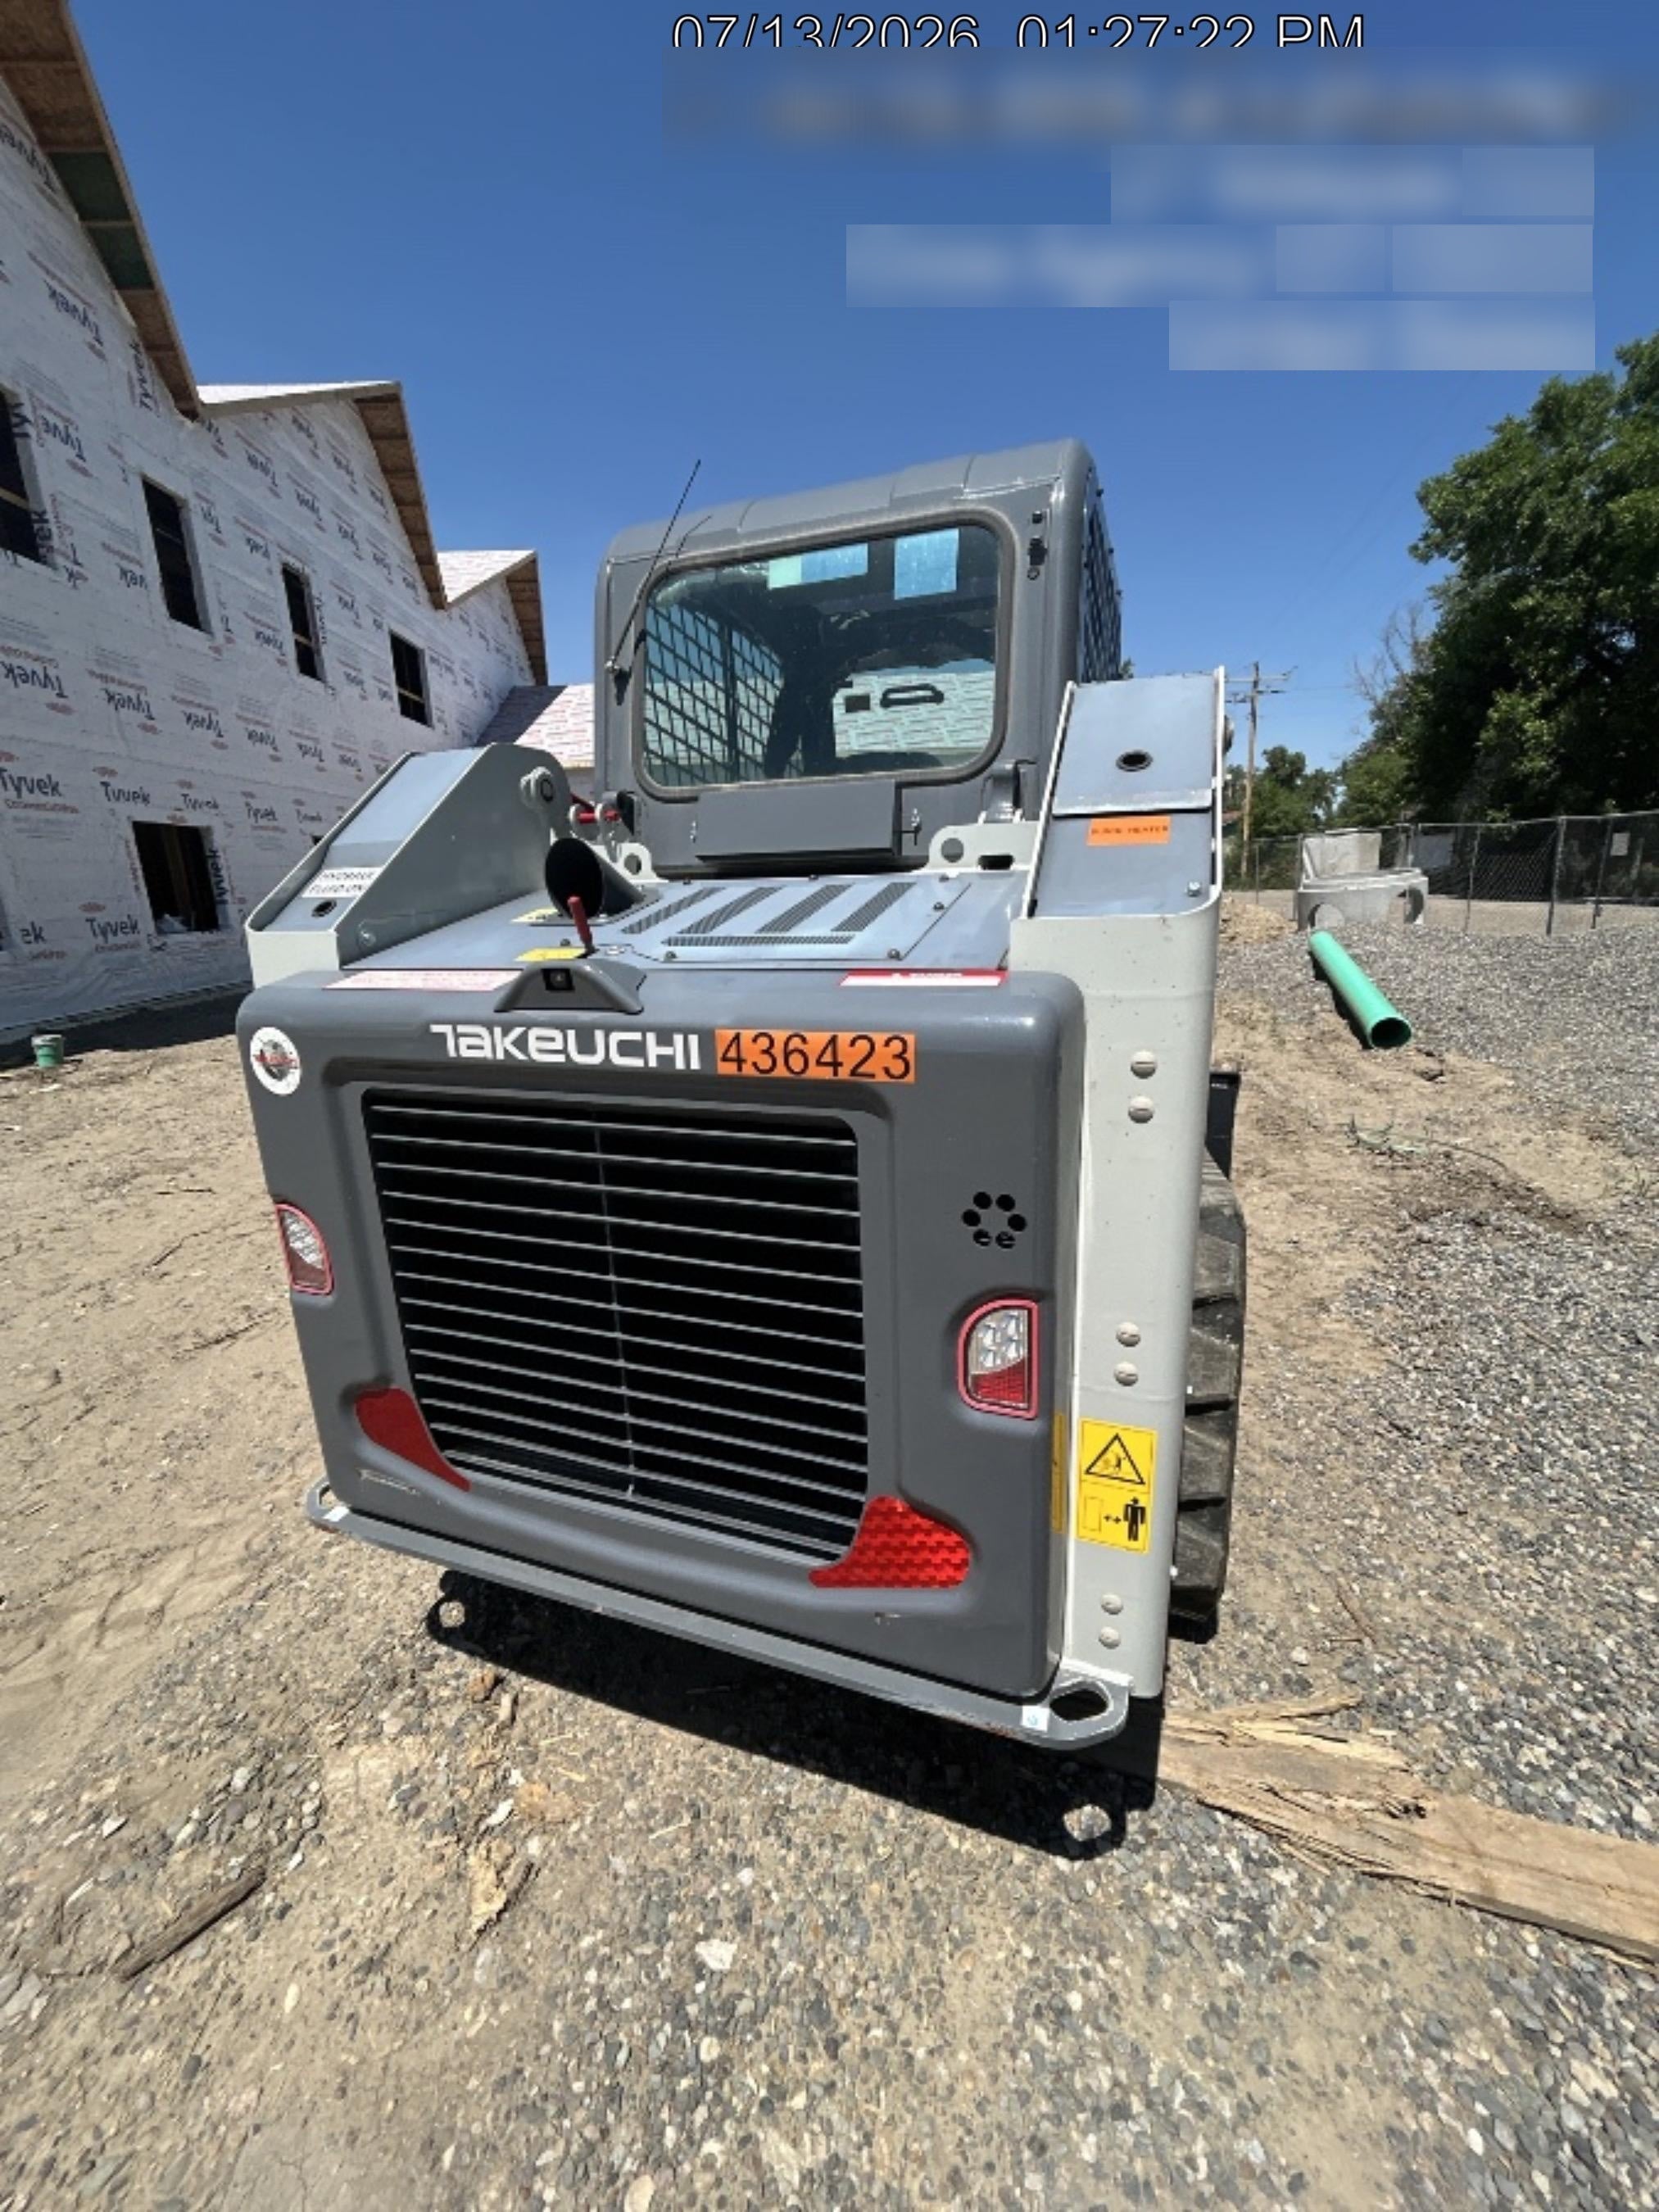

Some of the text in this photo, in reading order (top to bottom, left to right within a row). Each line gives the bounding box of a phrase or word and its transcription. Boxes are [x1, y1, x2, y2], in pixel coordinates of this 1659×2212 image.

[0, 660, 69, 699] Tyvek
[100, 687, 156, 721] Tyvek
[0, 768, 62, 800] Tyvek
[99, 781, 151, 806] Tyvek
[84, 914, 140, 945] Tyvek
[720, 1031, 911, 1080] 436423
